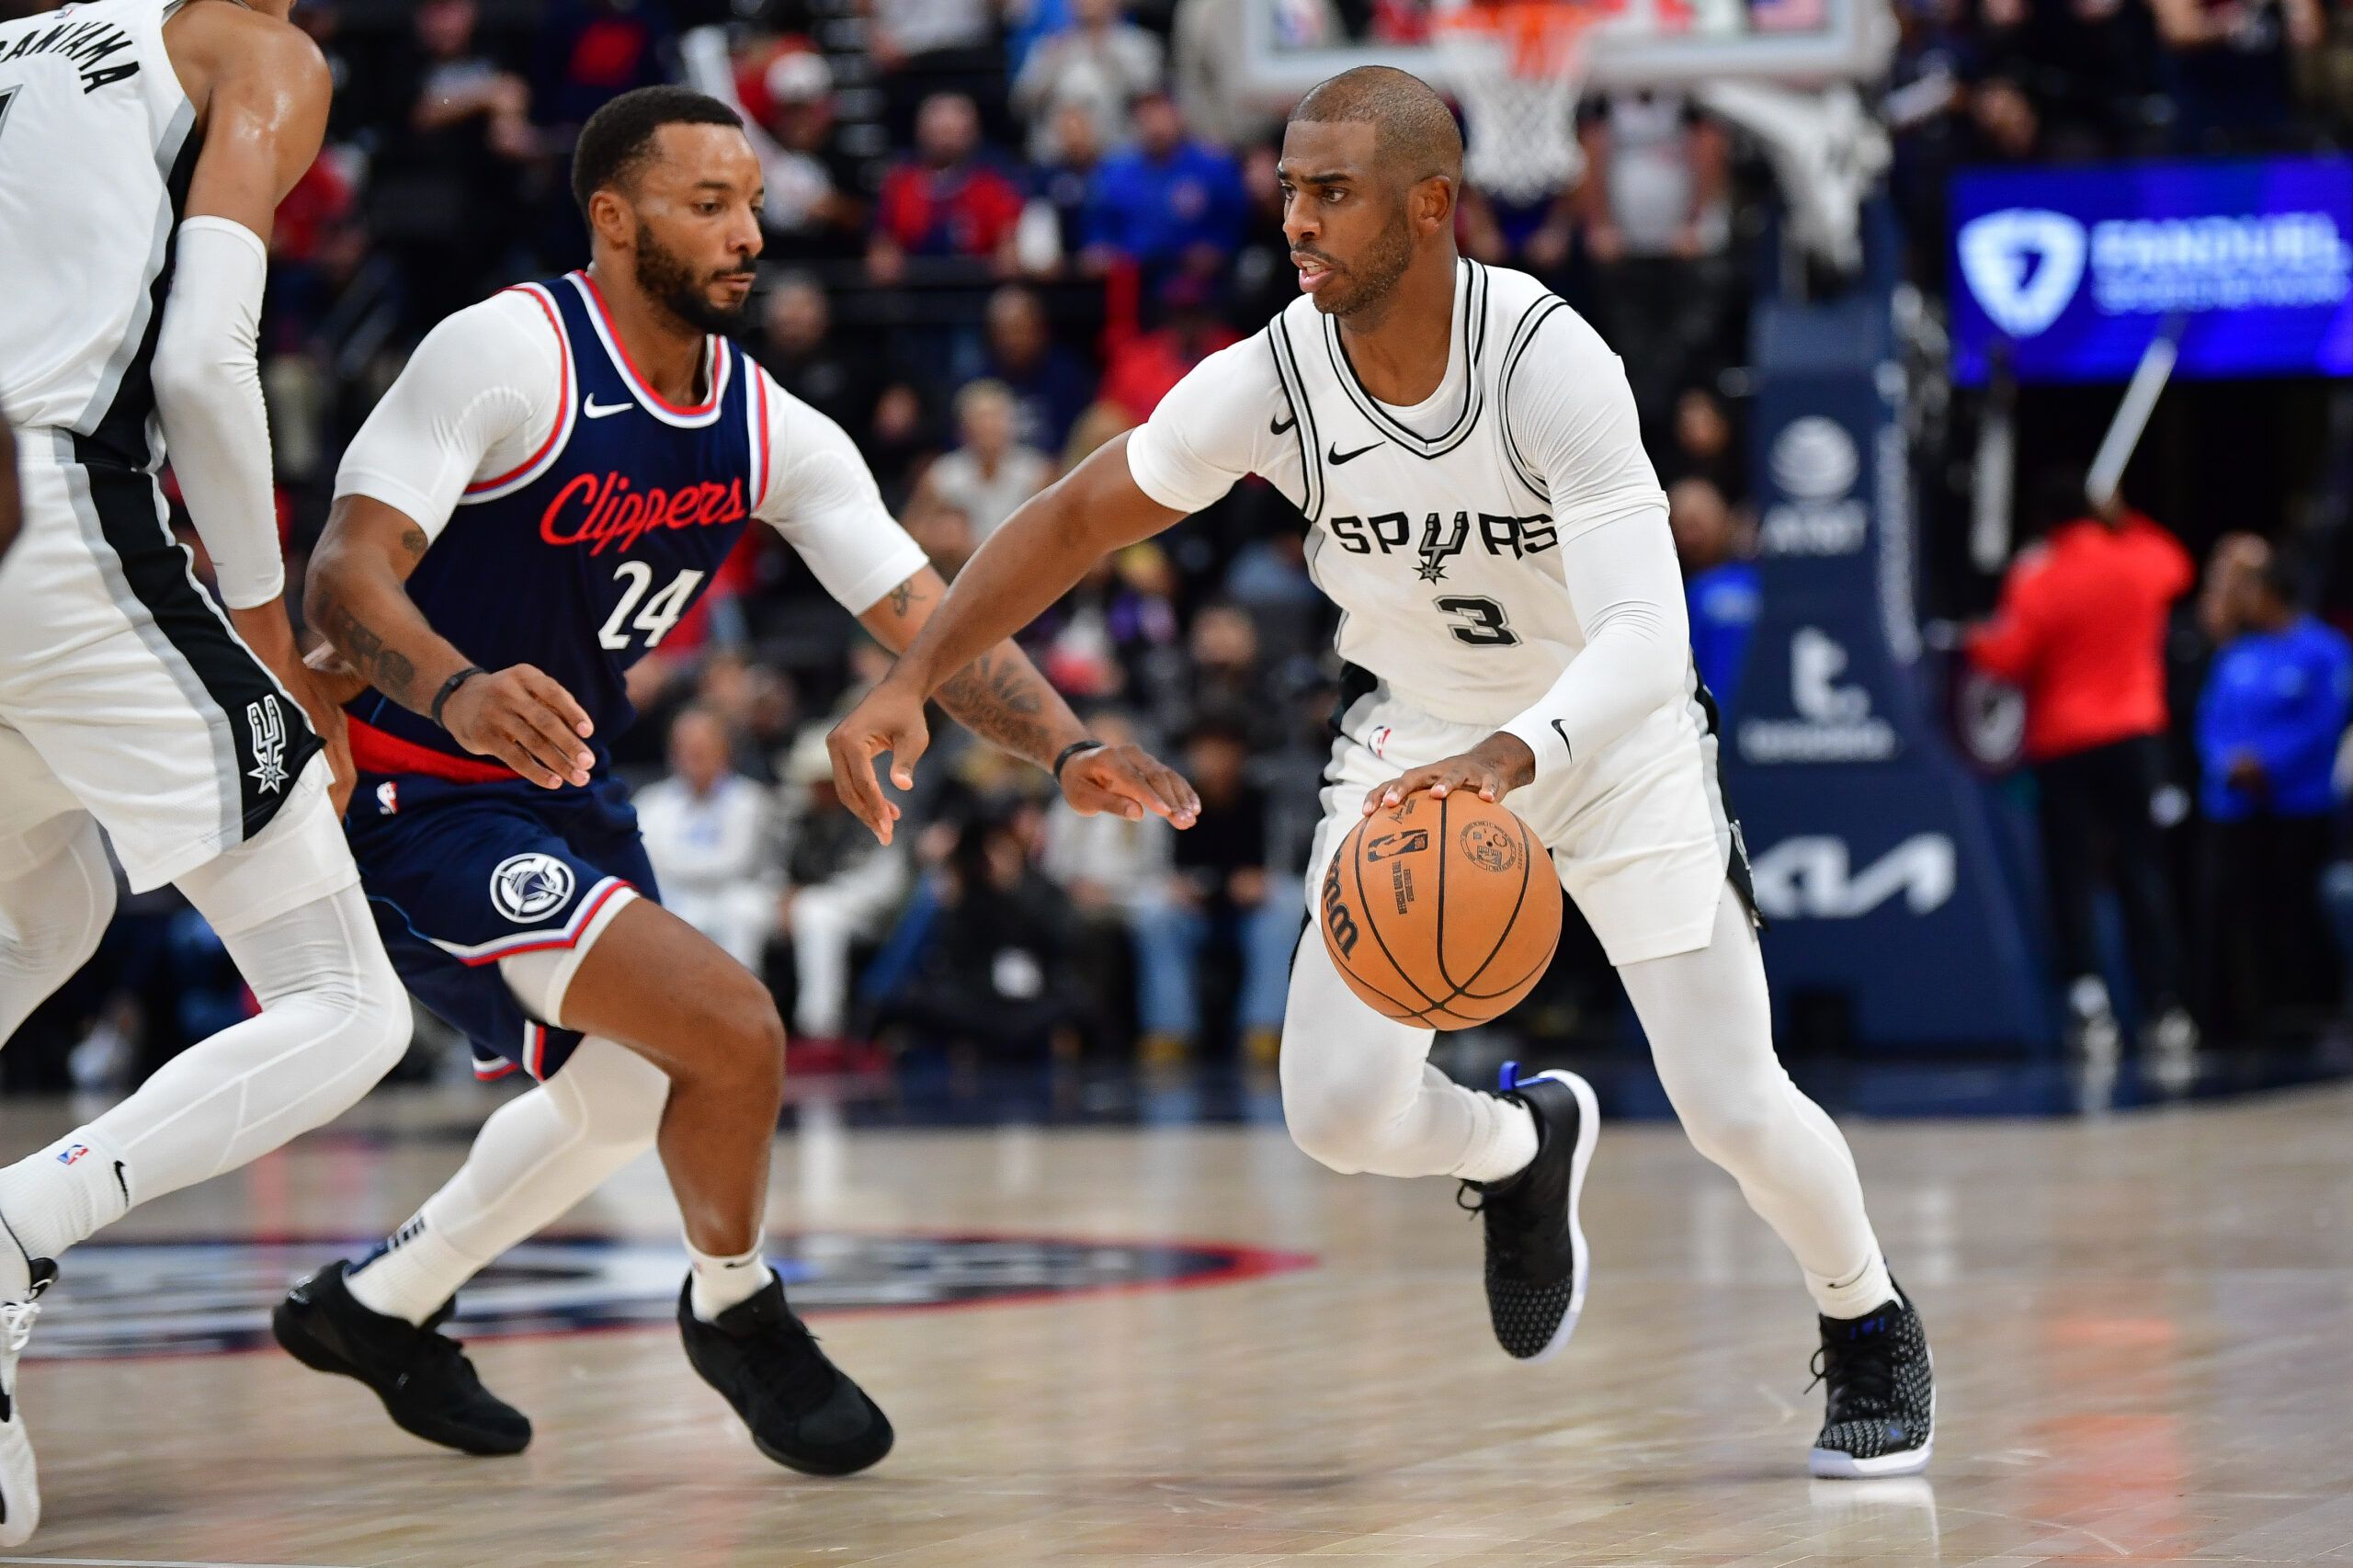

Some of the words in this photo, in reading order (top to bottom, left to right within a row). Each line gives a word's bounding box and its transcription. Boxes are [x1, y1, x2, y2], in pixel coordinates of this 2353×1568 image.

[540, 471, 745, 557] Clippers
[1330, 511, 1558, 586] SPURS
[597, 560, 705, 650] 24
[1432, 594, 1523, 648] 3
